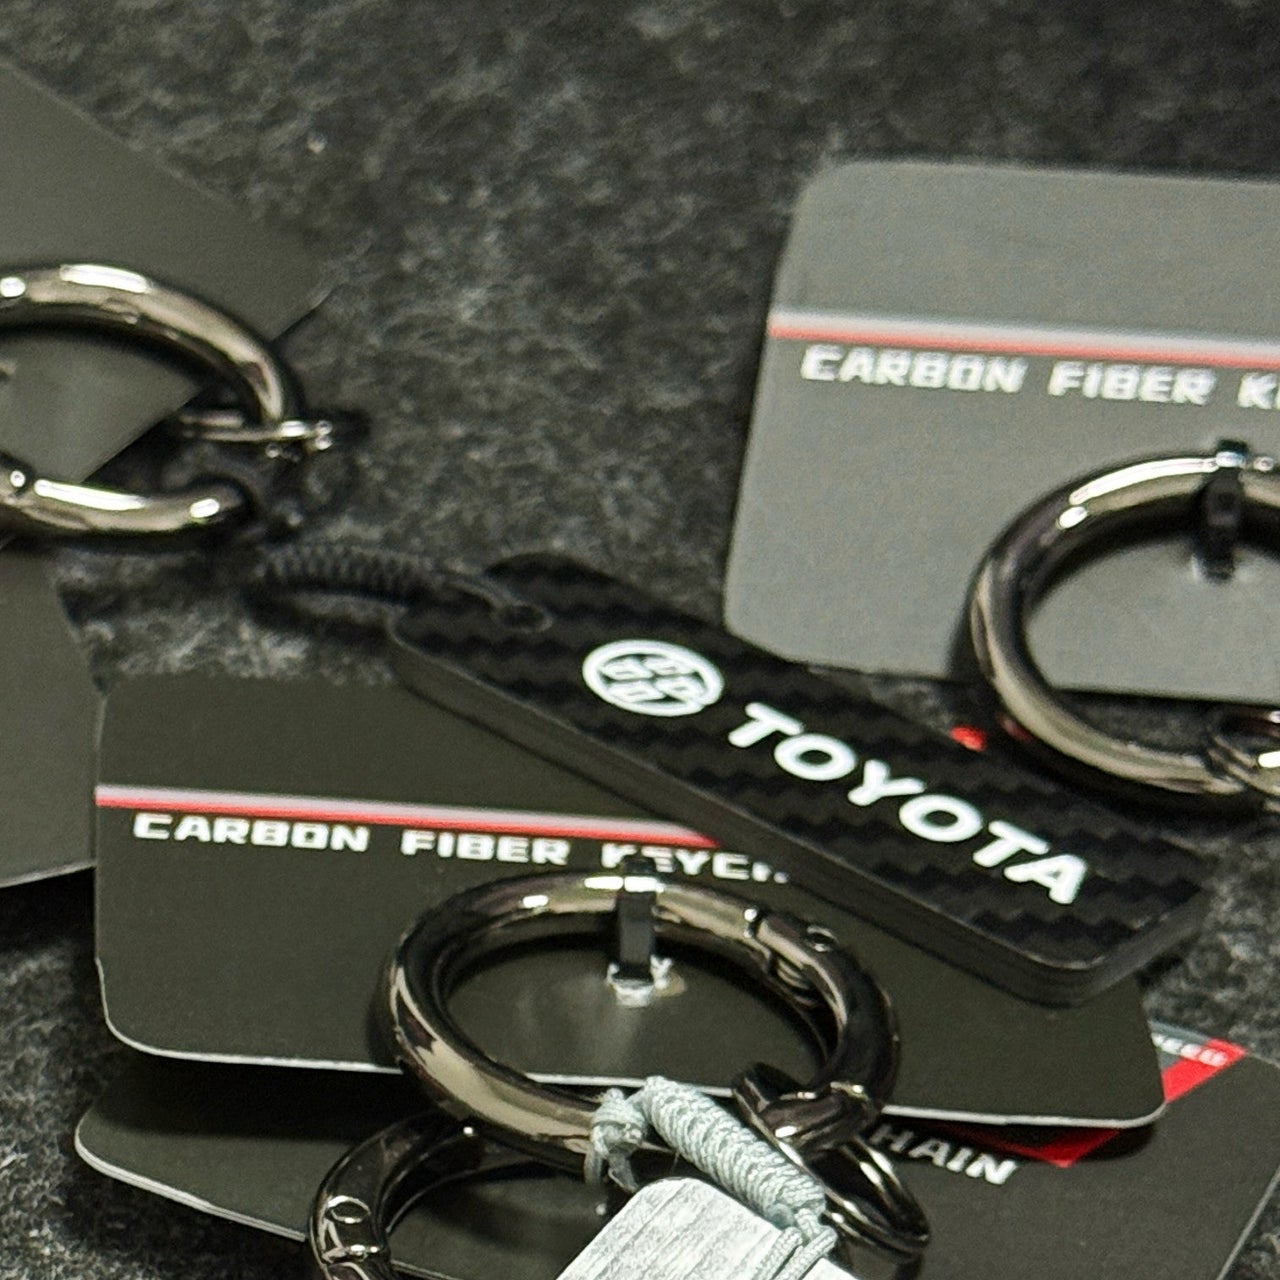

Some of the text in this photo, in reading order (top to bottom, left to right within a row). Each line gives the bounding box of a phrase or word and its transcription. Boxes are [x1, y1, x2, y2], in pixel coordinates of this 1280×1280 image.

[800, 343, 1280, 410] CARBON FIBER K
[728, 703, 1087, 904] TOYOTA
[133, 812, 369, 852] CARBON
[401, 829, 570, 866] FIBER
